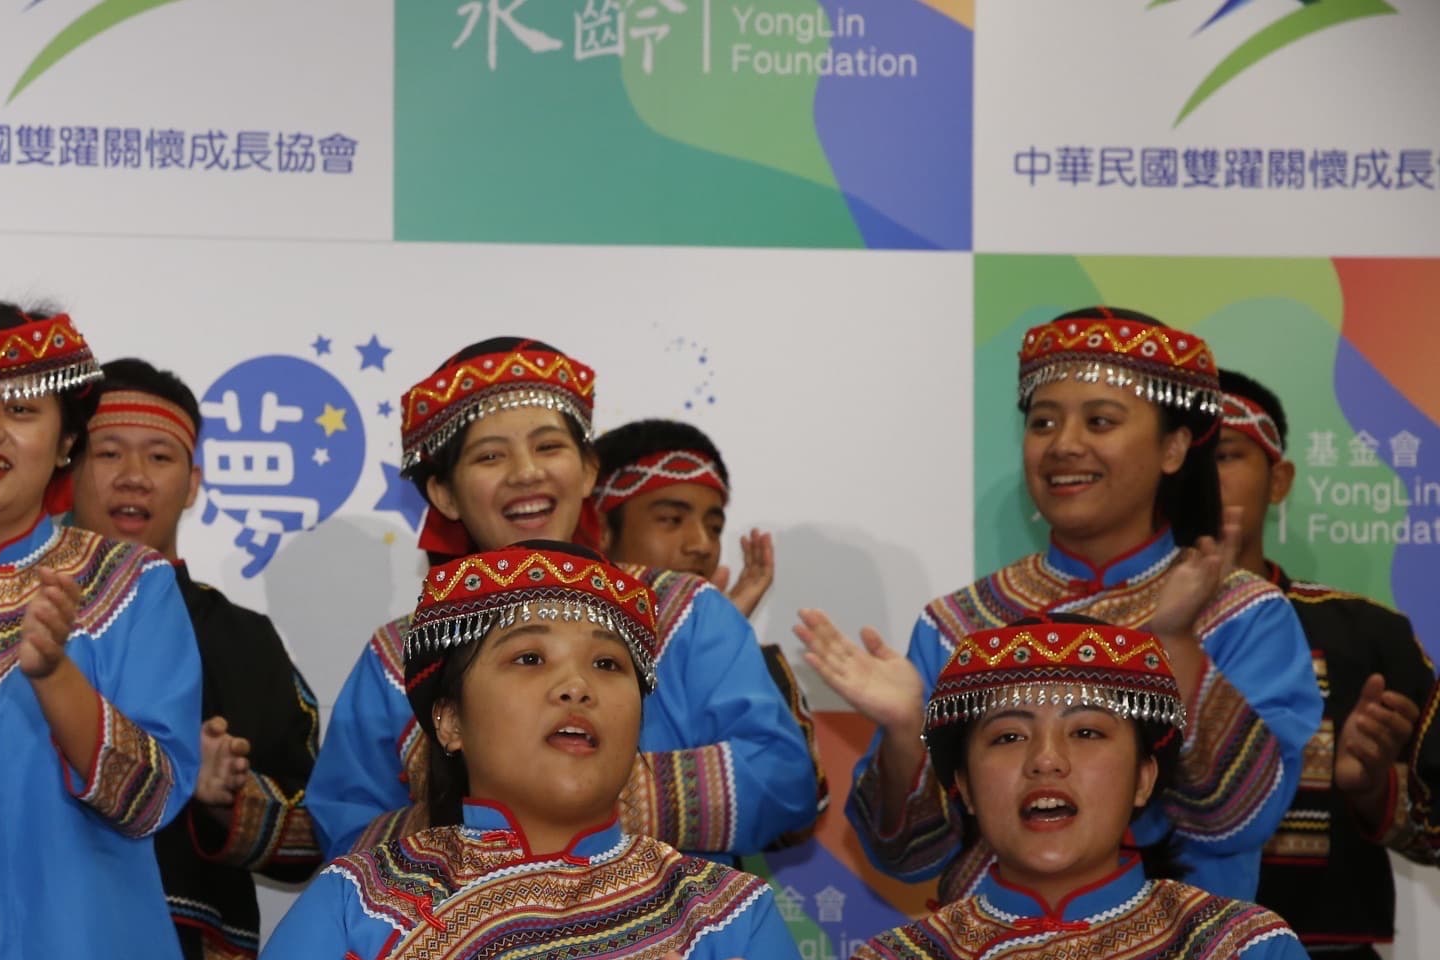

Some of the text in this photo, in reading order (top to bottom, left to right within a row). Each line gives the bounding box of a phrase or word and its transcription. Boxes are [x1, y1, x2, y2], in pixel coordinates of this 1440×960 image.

[731, 7, 865, 44] YongLin
[731, 45, 918, 77] Foundation
[1305, 430, 1421, 468] 基金會
[1307, 475, 1440, 514] YongLin
